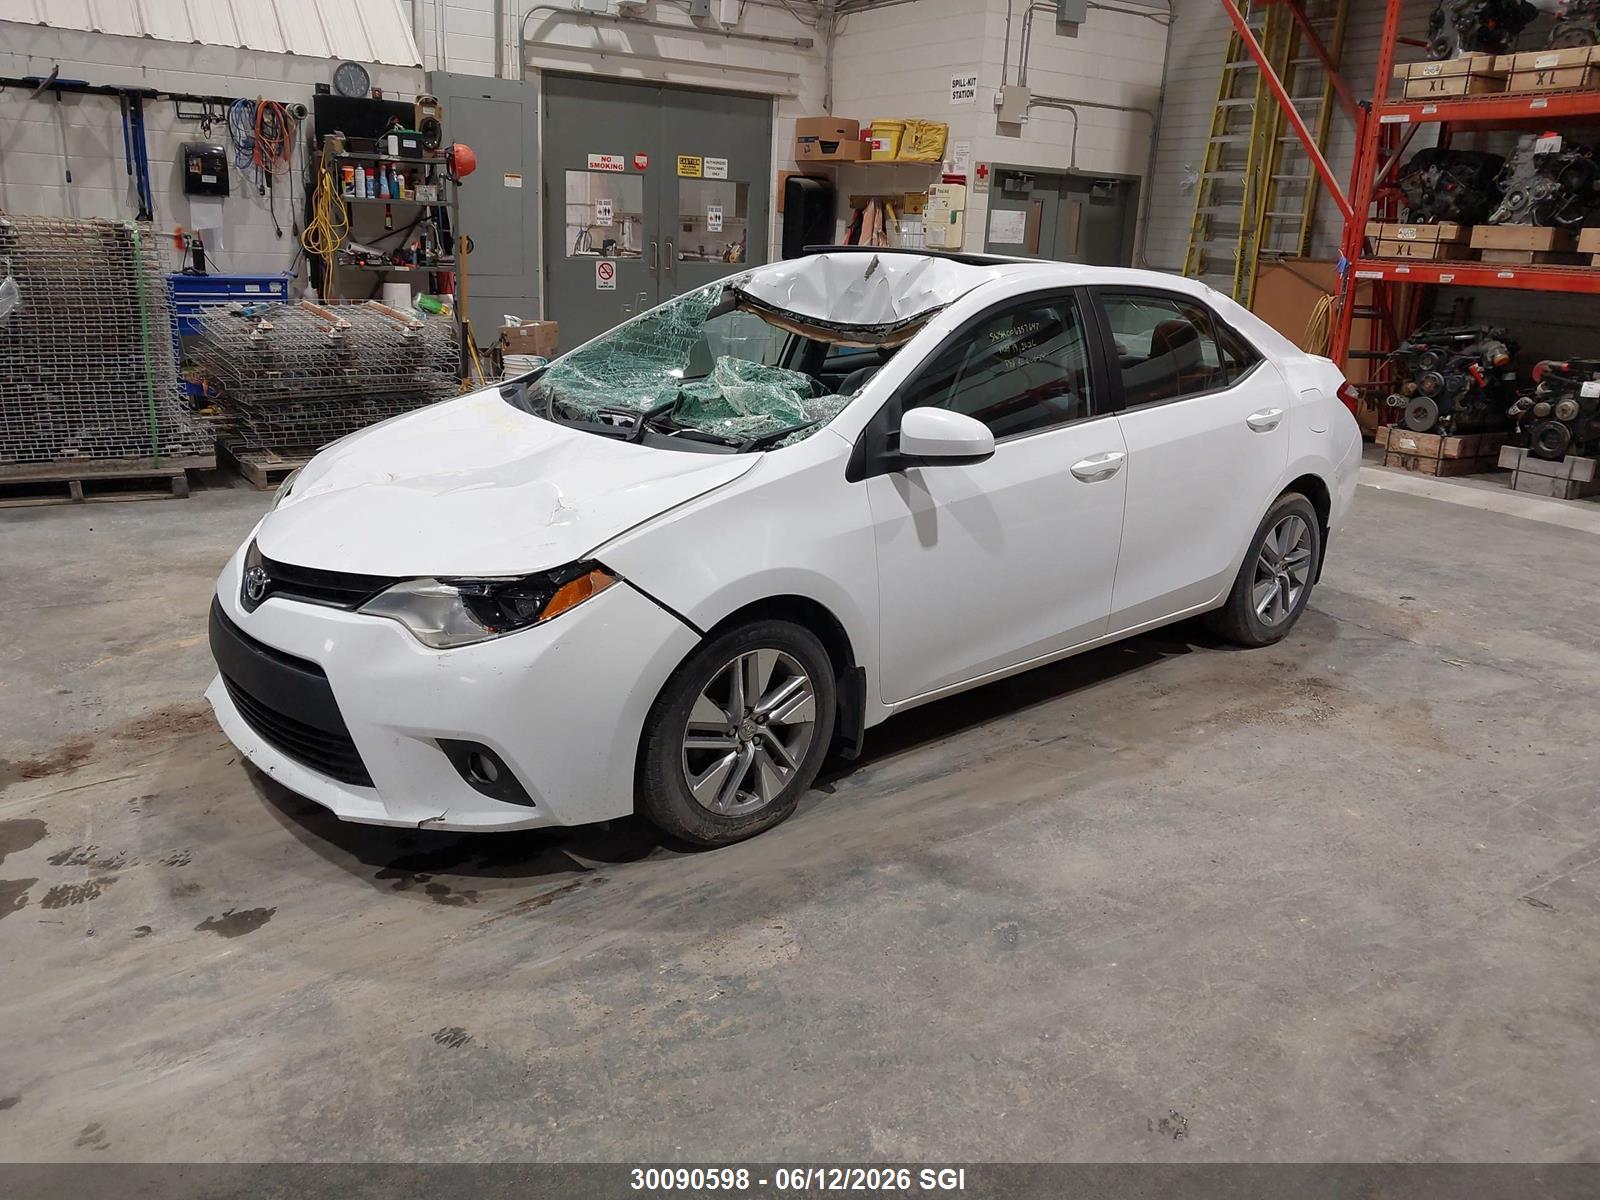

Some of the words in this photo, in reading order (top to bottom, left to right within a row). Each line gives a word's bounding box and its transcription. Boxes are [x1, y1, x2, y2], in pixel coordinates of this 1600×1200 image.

[952, 77, 977, 88] SPILL-KIT
[952, 89, 974, 100] STATION
[589, 162, 624, 170] SMOKING
